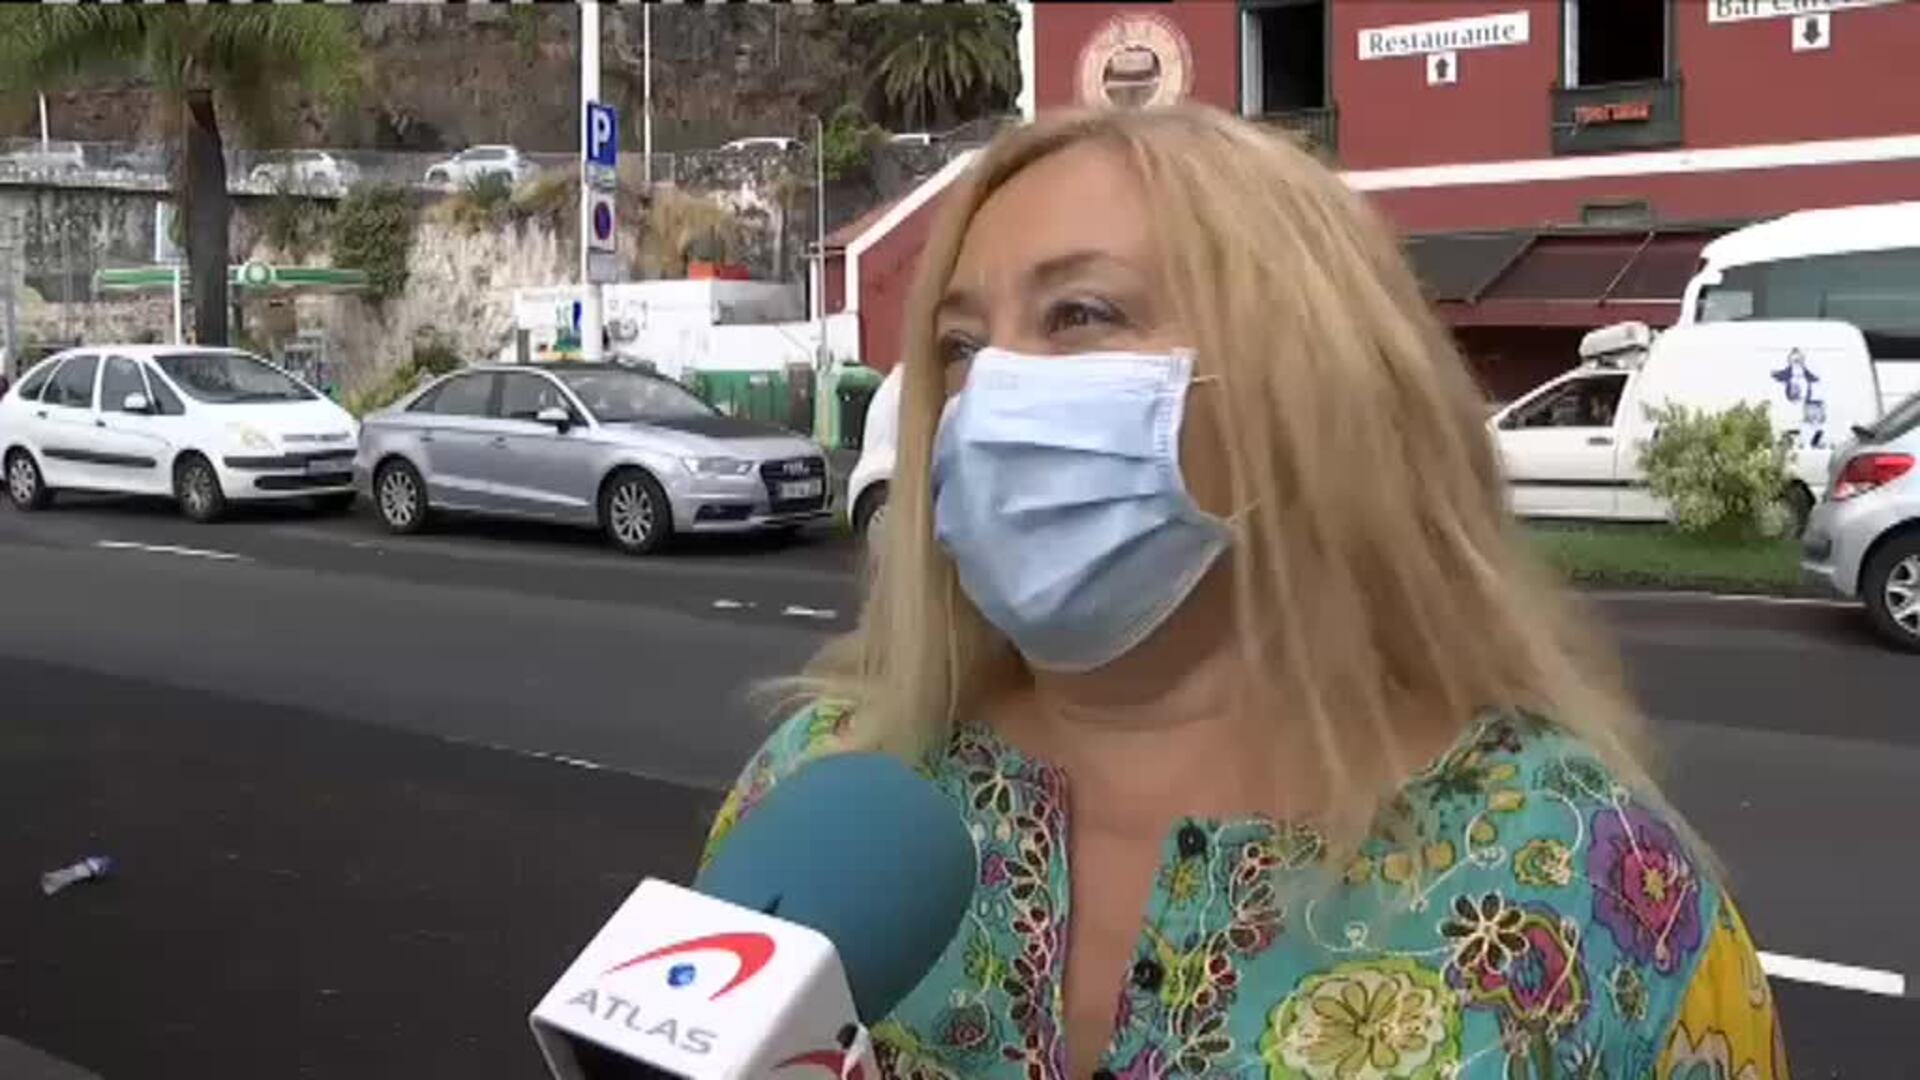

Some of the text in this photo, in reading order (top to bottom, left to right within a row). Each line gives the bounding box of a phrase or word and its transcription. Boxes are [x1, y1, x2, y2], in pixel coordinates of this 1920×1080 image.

[1369, 23, 1516, 53] Restaurante
[592, 107, 611, 158] P
[567, 988, 717, 1055] ATLAS
